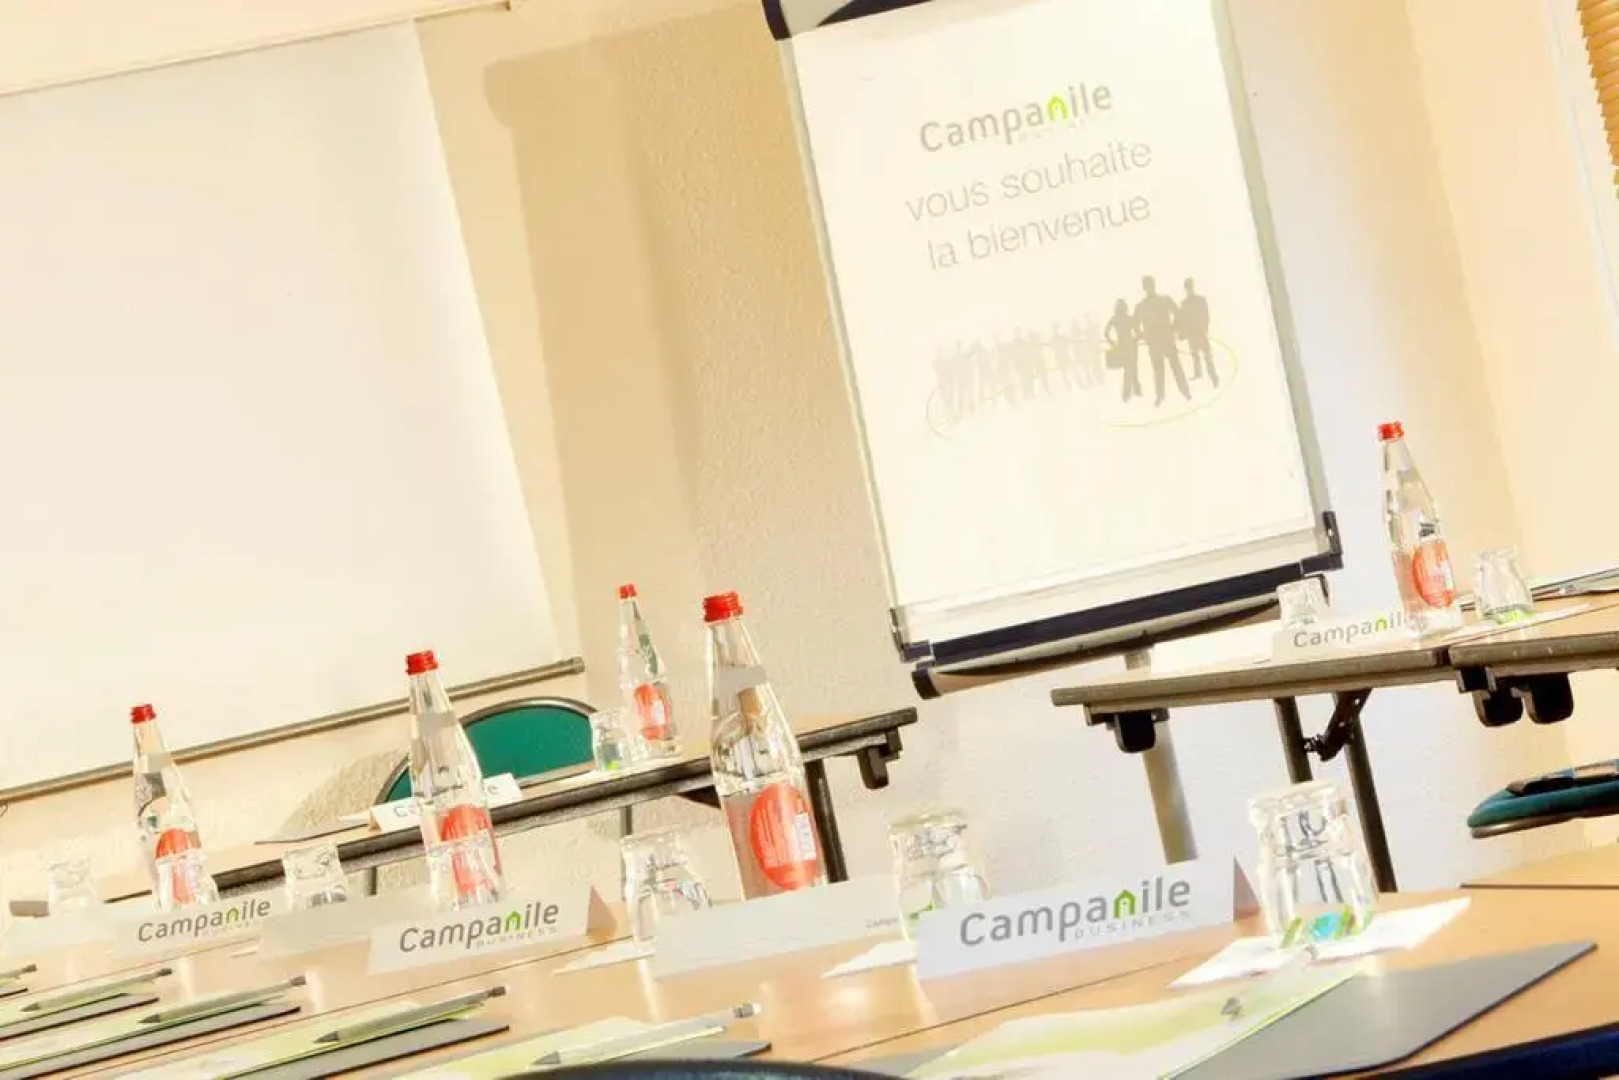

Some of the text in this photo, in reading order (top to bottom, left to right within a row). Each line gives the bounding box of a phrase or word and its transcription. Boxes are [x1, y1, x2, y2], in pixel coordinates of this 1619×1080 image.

[919, 82, 1113, 152] Campanile
[905, 141, 1152, 222] vous souhaite
[927, 195, 1151, 270] la bienvenue
[138, 898, 272, 942] Campanile
[400, 902, 559, 952] Campanile
[960, 876, 1191, 947] Campanile
